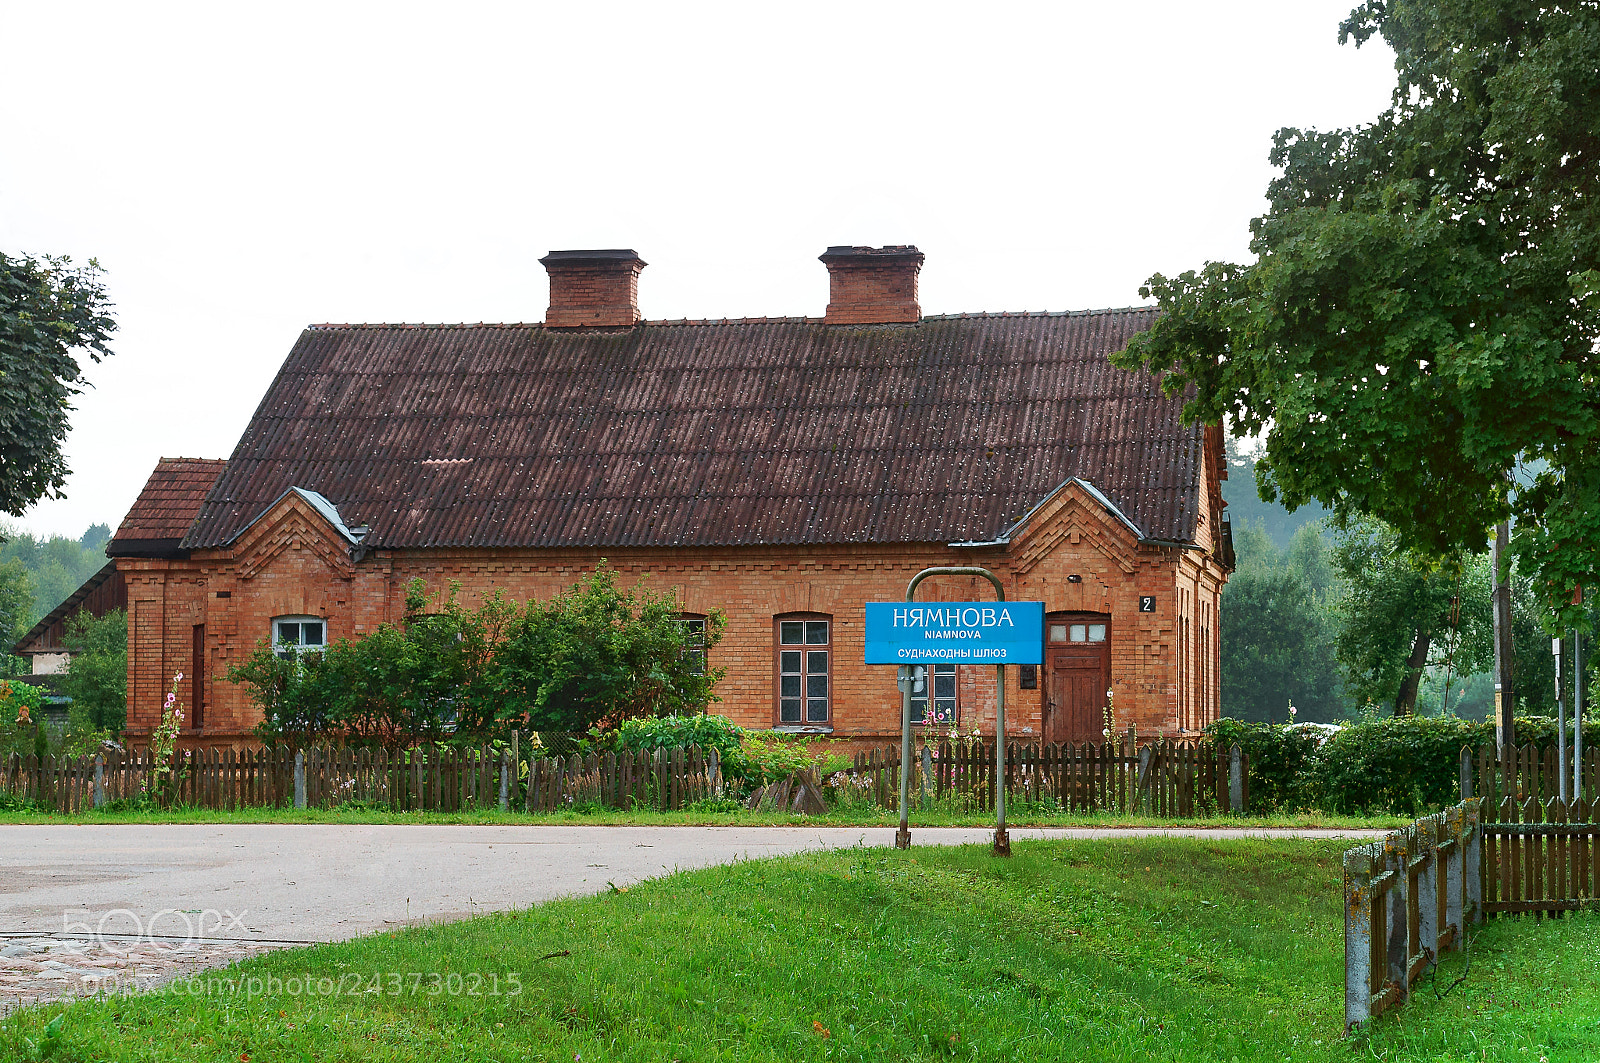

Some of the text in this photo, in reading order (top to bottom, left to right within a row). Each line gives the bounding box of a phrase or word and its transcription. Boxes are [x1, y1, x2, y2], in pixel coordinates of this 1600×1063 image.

[1143, 597, 1151, 611] 2
[893, 608, 1014, 627] НЯМНОВА
[924, 630, 981, 639] NIAMNOVA
[898, 648, 1007, 659] СУДНАХОДНЫ ШЛЮЗ
